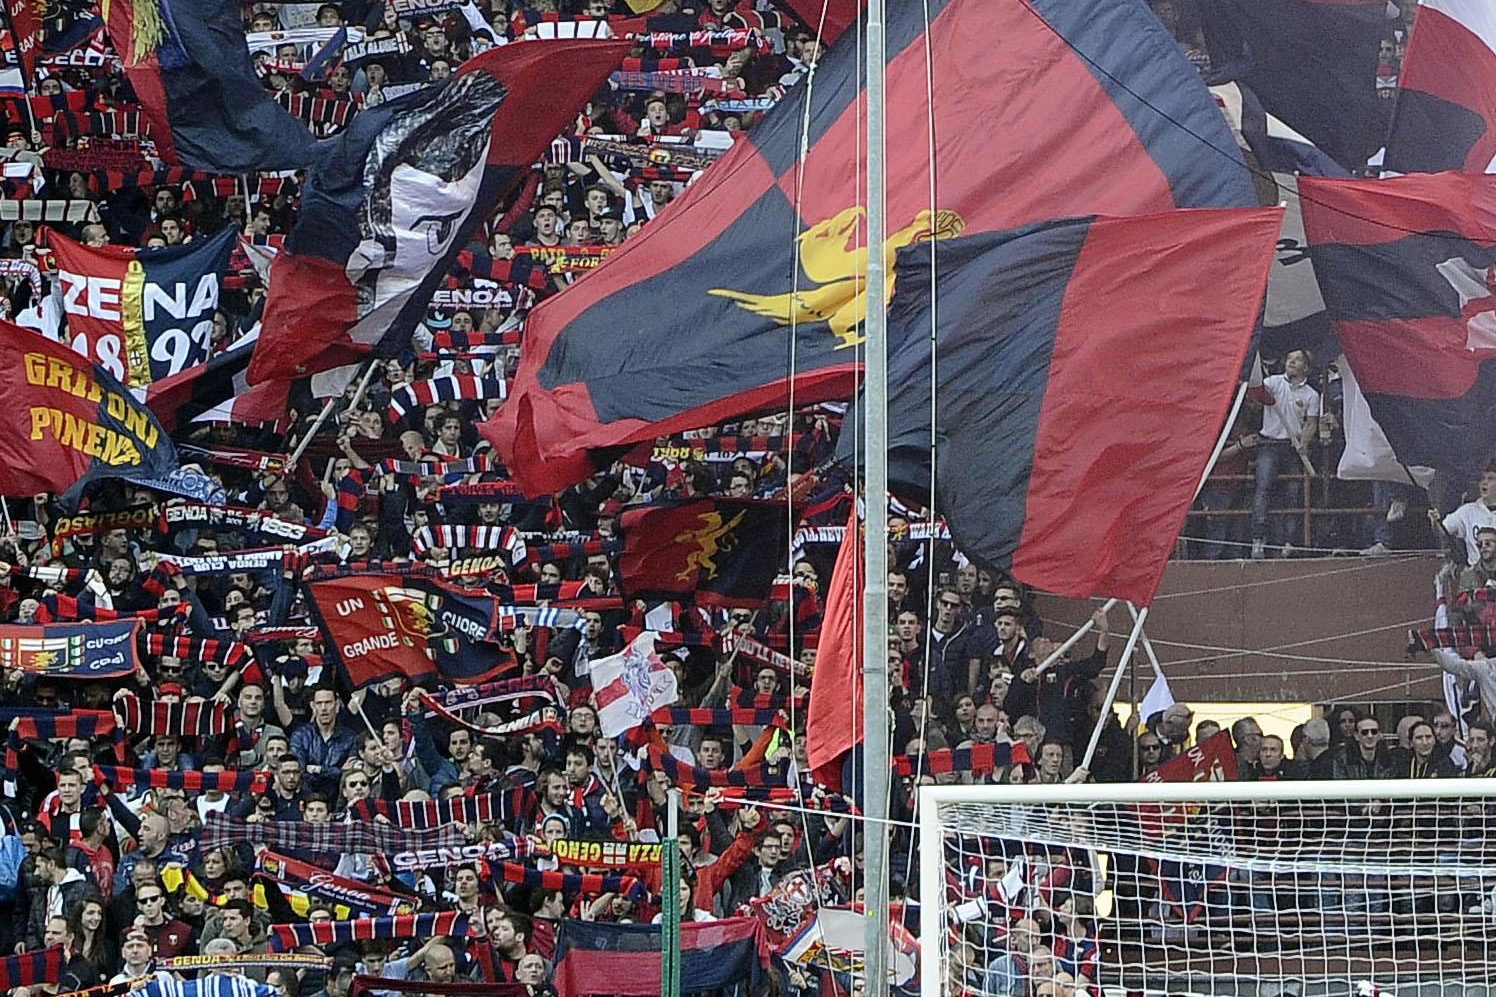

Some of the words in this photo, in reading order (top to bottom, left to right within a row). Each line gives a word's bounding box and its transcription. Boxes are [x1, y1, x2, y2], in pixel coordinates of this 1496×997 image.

[57, 267, 219, 320] ZENA
[433, 289, 513, 304] ENOA
[166, 505, 207, 524] GENOA
[450, 555, 505, 575] GENOA
[336, 597, 365, 617] UN
[441, 610, 488, 640] CUORE
[86, 631, 131, 650] CUORE
[342, 631, 401, 659] GRANDE
[629, 843, 664, 862] RZA
[299, 869, 371, 901] Genoa
[172, 954, 220, 967] GENOA
